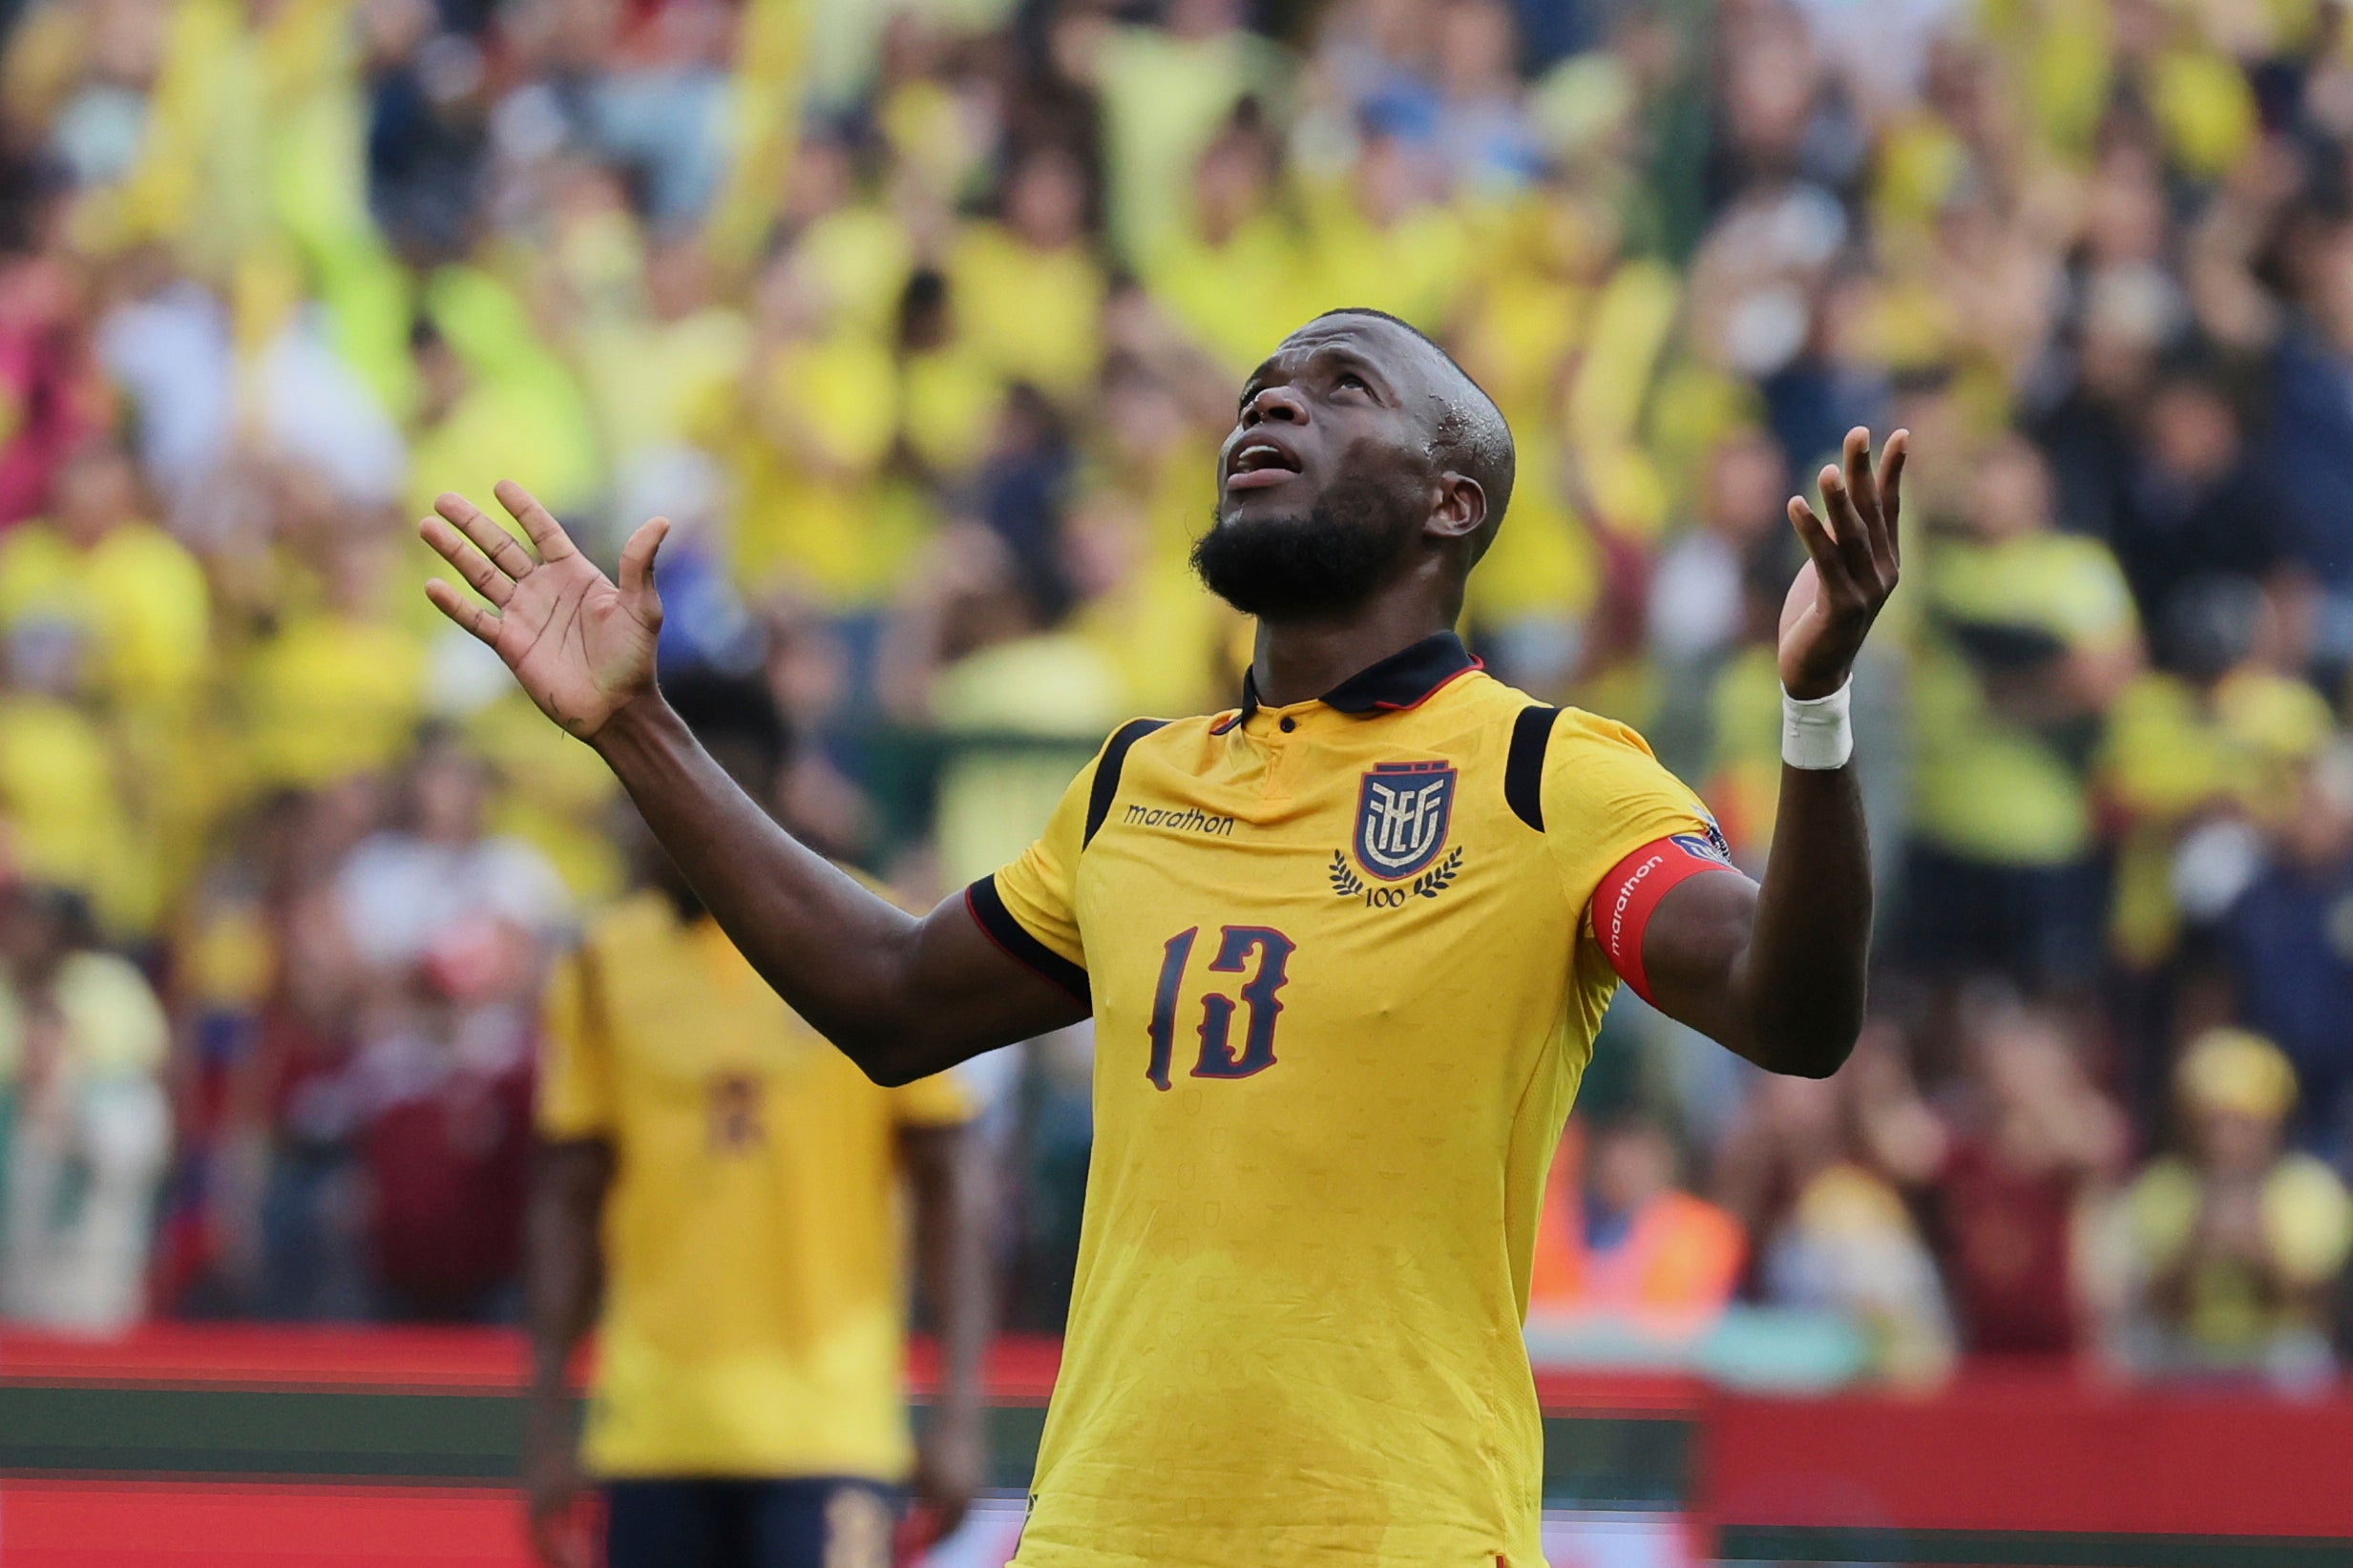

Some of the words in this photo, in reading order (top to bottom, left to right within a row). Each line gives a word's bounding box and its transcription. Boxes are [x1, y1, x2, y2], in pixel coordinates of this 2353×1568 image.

[1124, 805, 1234, 836] marathon
[1366, 887, 1406, 908] 100
[1611, 855, 1664, 956] marathon
[1145, 925, 1296, 1091] 13
